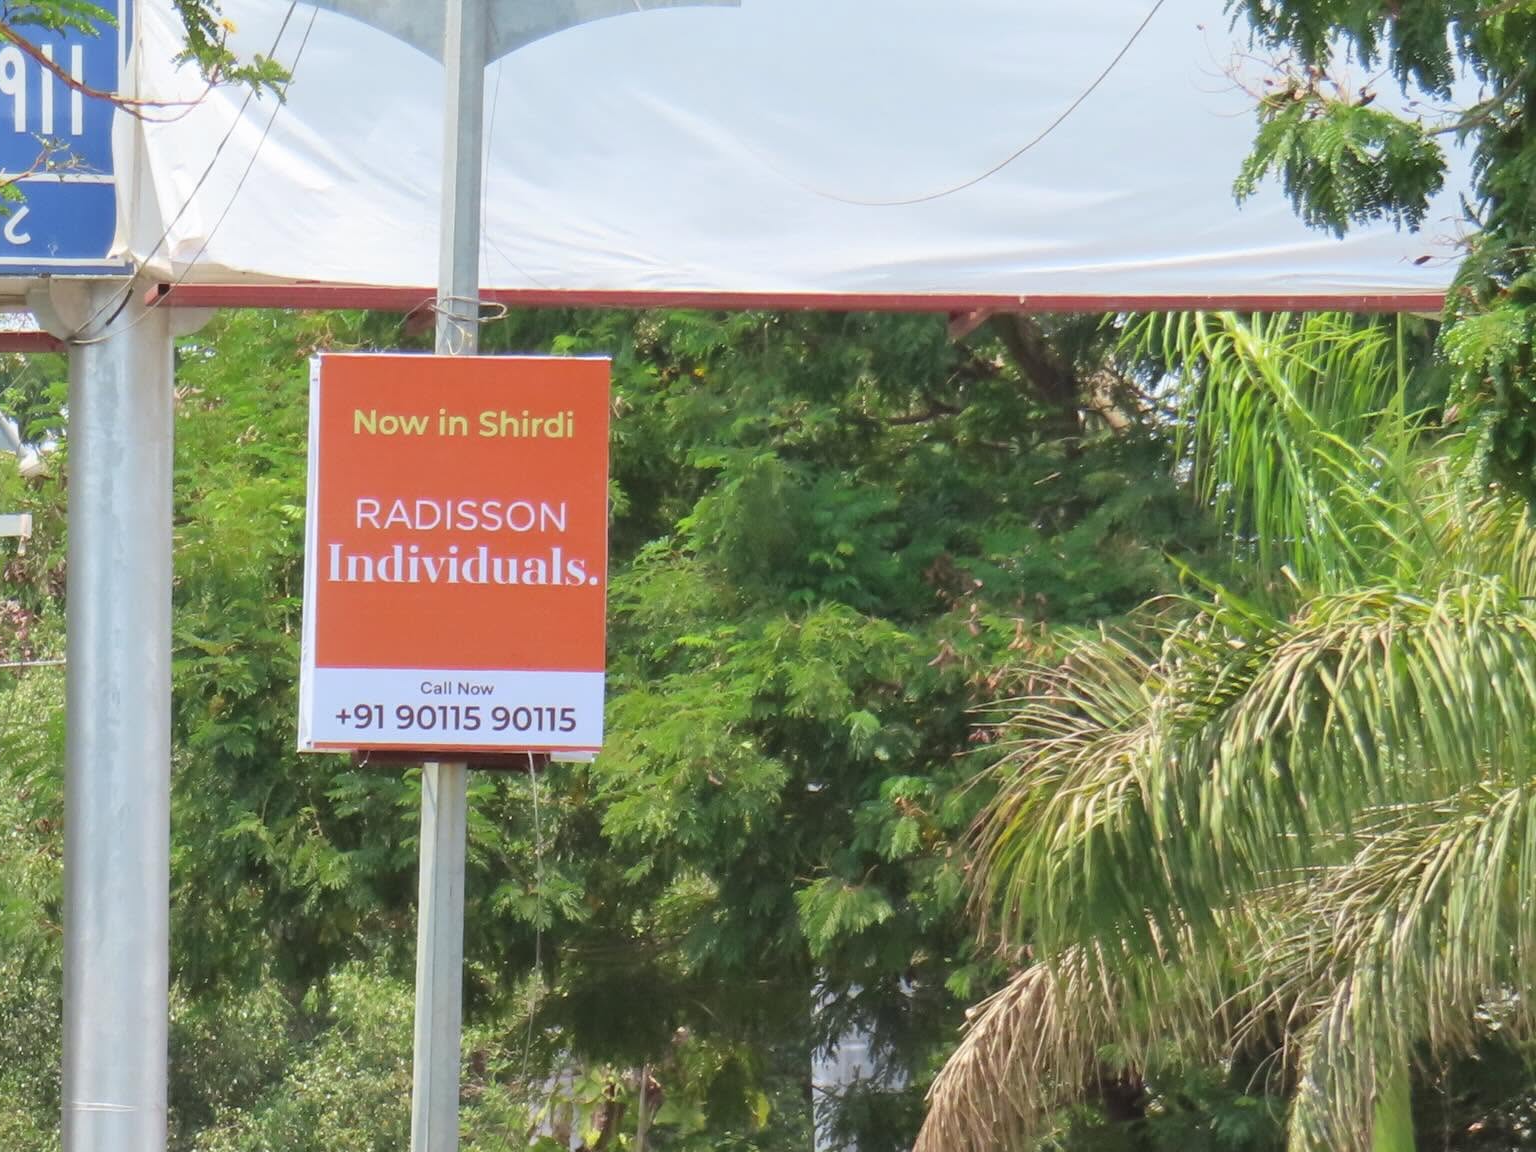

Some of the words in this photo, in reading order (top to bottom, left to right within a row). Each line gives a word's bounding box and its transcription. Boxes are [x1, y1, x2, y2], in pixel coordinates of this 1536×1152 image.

[353, 408, 429, 436] Now
[438, 408, 469, 437] in
[478, 410, 575, 439] Shirdi
[355, 498, 567, 533] RADISSON
[327, 543, 599, 586] Individuals.
[420, 681, 453, 696] Call
[457, 682, 495, 696] Now
[335, 704, 384, 730] +91
[395, 705, 481, 731] 90115
[491, 706, 577, 732] 90115
